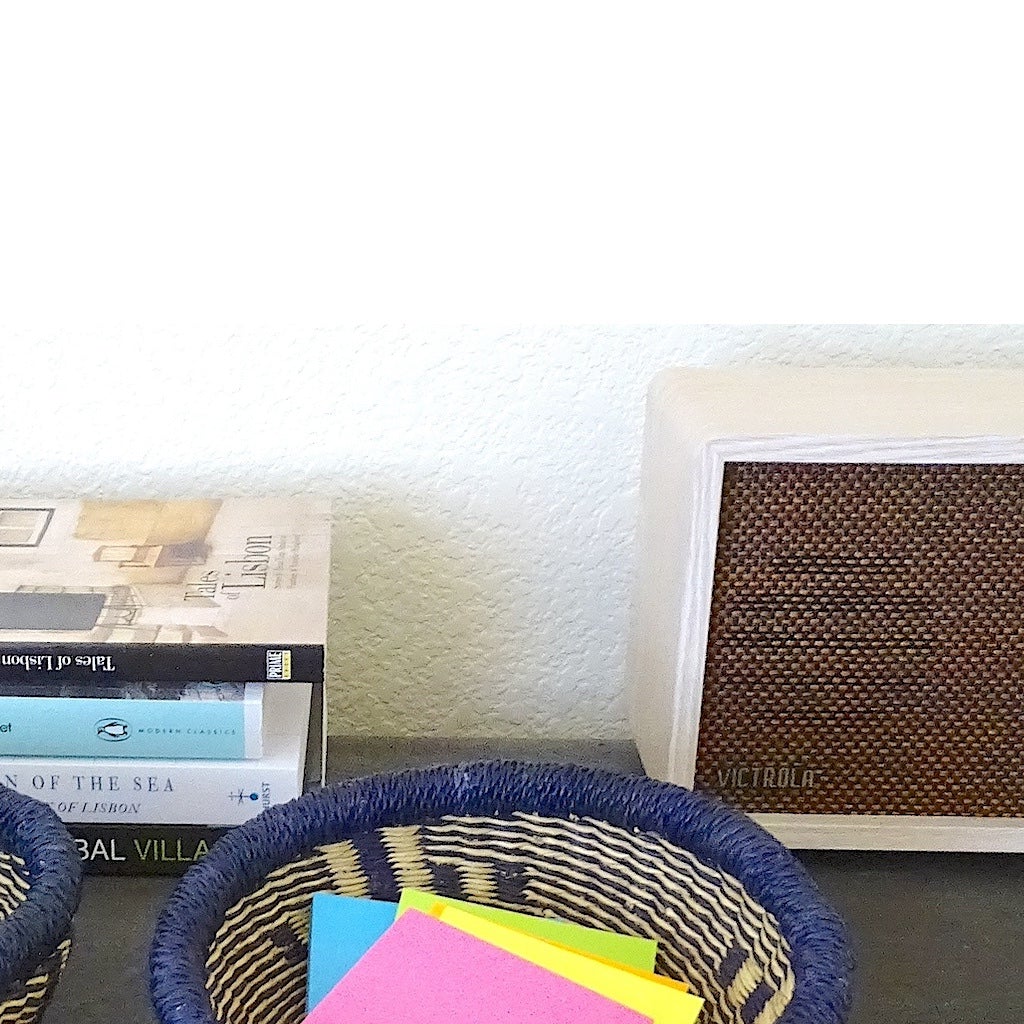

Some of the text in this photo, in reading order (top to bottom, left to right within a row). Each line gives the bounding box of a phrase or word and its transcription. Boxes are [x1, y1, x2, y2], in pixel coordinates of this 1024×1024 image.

[221, 535, 273, 589] Lisbon
[183, 570, 220, 601] Tales
[1, 653, 116, 671] Tales of Lisbon
[32, 774, 60, 790] OF
[73, 775, 120, 791] THE
[133, 777, 175, 792] SEA
[718, 766, 814, 788] VICTROLA
[57, 801, 141, 814] OF LISBON
